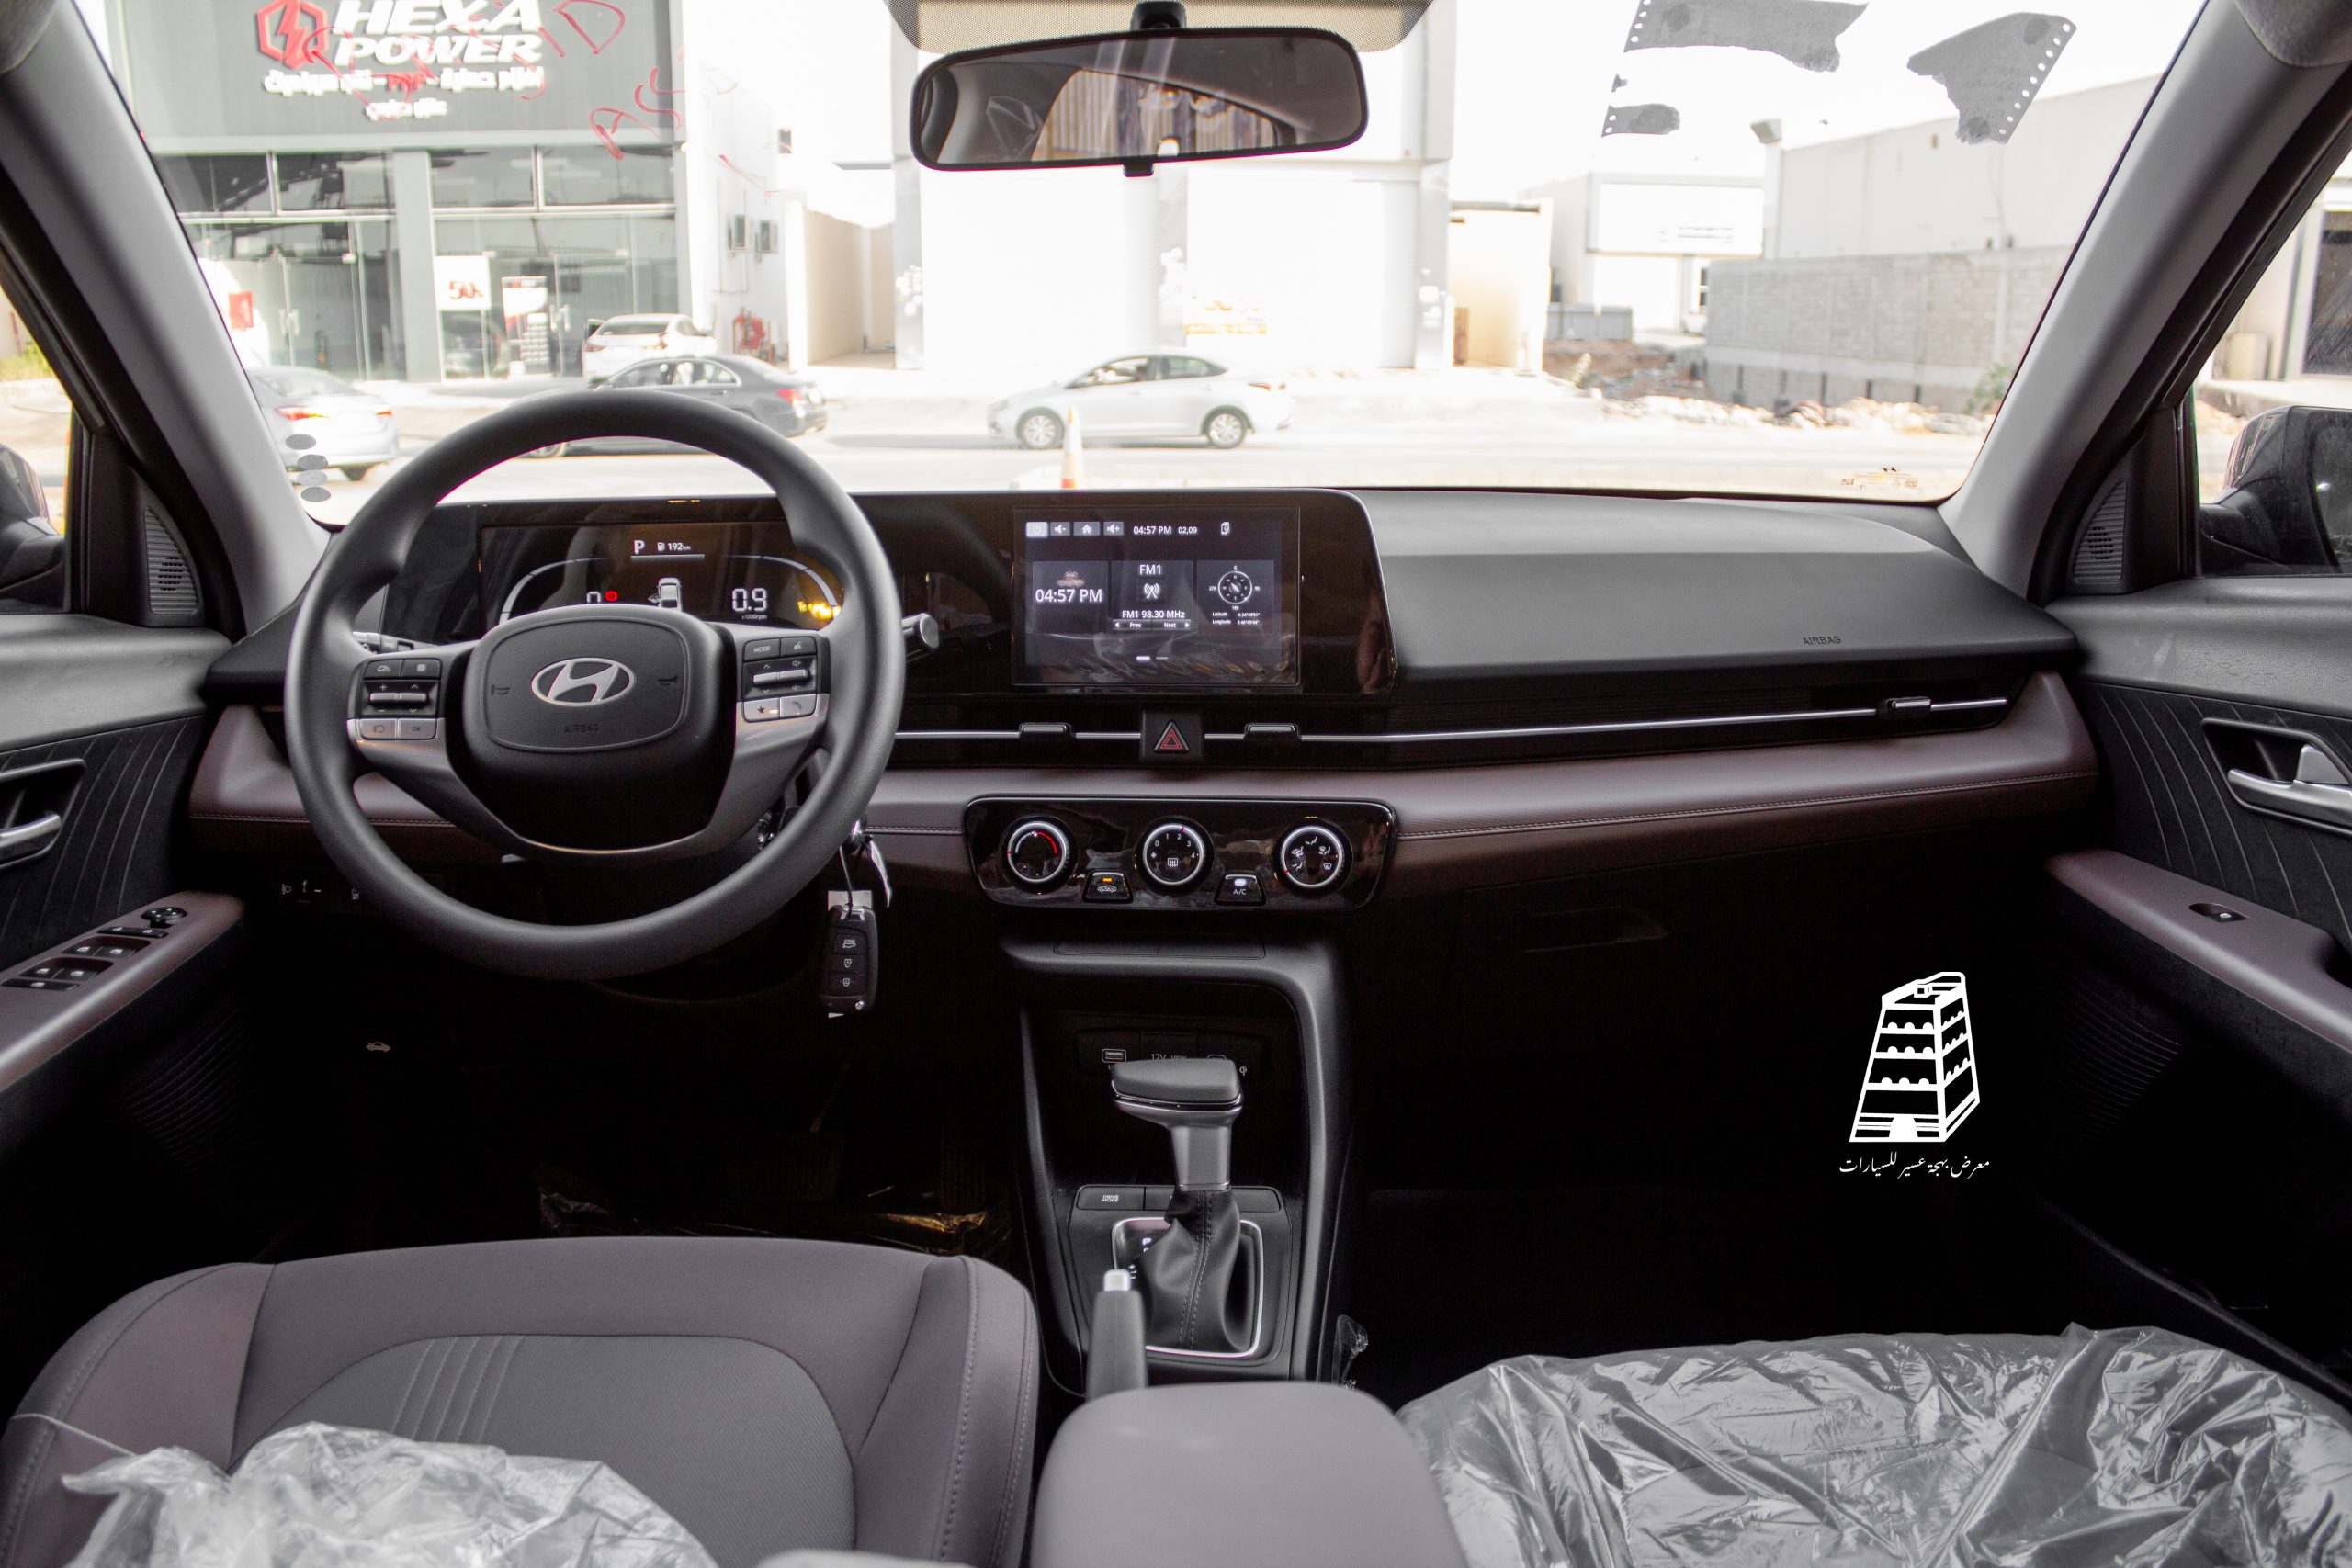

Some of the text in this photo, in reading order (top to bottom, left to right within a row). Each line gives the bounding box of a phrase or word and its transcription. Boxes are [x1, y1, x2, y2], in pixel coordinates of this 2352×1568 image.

[332, 0, 542, 34] HEXA
[334, 34, 544, 66] POWER
[1133, 525, 1157, 535] 04:57
[1158, 525, 1171, 535] PM
[633, 540, 645, 553] P
[1139, 564, 1162, 575] FM1
[731, 588, 768, 613] 0.9
[1035, 588, 1103, 603] 04:57 PM
[1122, 610, 1185, 619] FM1 98.30 MHz
[1129, 621, 1142, 629] Prev
[1163, 621, 1177, 629] Next
[1803, 636, 1842, 646] AIRBAG
[752, 645, 771, 653] MODE
[563, 723, 600, 734] AIRBAG
